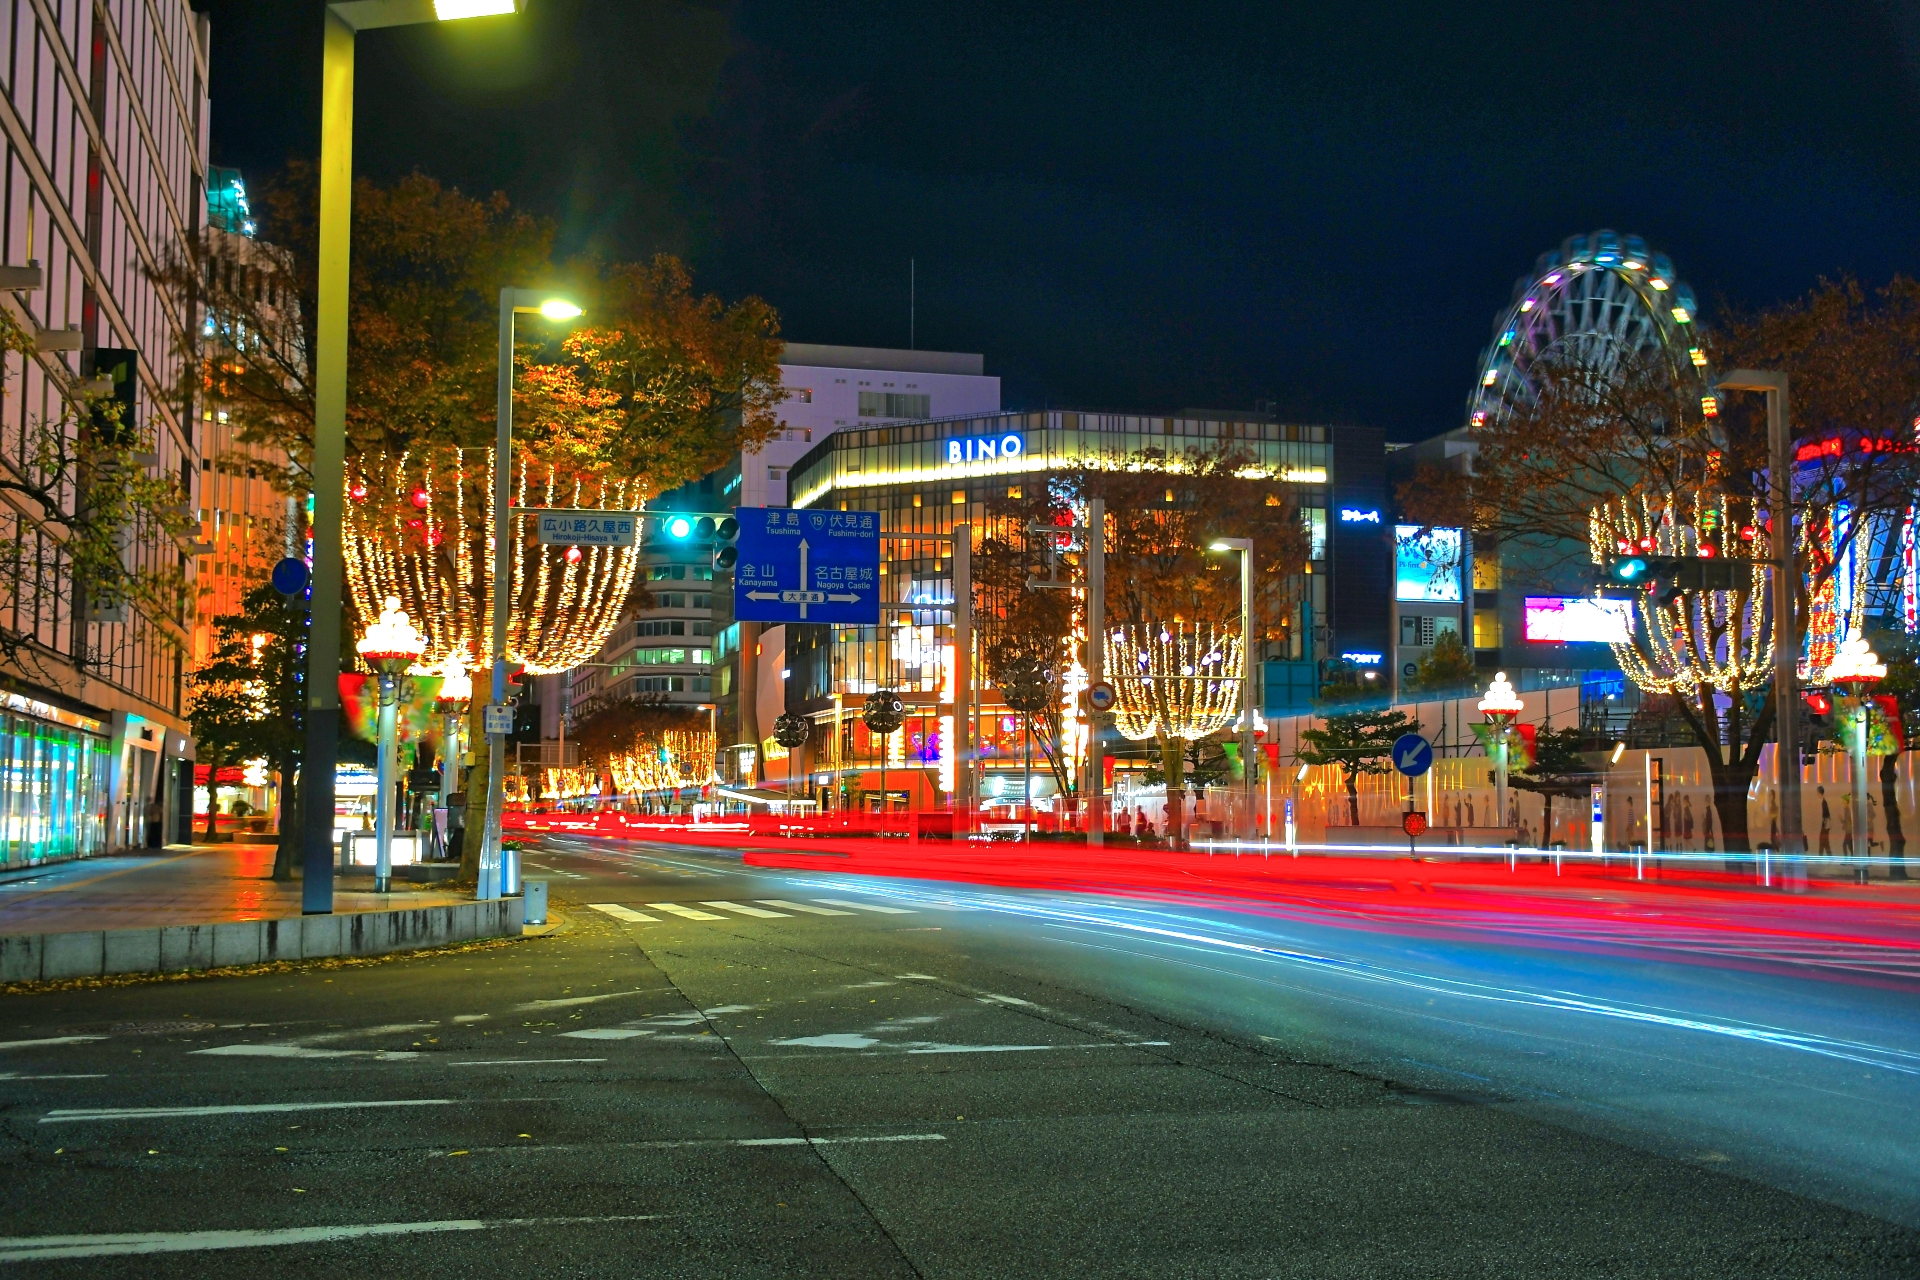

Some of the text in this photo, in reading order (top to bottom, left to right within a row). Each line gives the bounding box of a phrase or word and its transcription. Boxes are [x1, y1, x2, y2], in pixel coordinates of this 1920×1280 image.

[948, 435, 1022, 464] BINO
[767, 512, 800, 526] 津島
[812, 516, 823, 525] 19
[829, 514, 873, 529] 伏見通
[543, 518, 631, 534] 広小路久屋西
[766, 527, 801, 535] Tsushima
[552, 533, 608, 543] Hirokoji-Hisaya
[828, 529, 874, 538] Fushimi-dori
[742, 563, 775, 578] 金山
[815, 566, 873, 581] 名古屋城
[739, 578, 778, 588] Kanayama
[816, 581, 871, 590] Nagoya Castle
[788, 592, 819, 602] 大津通
